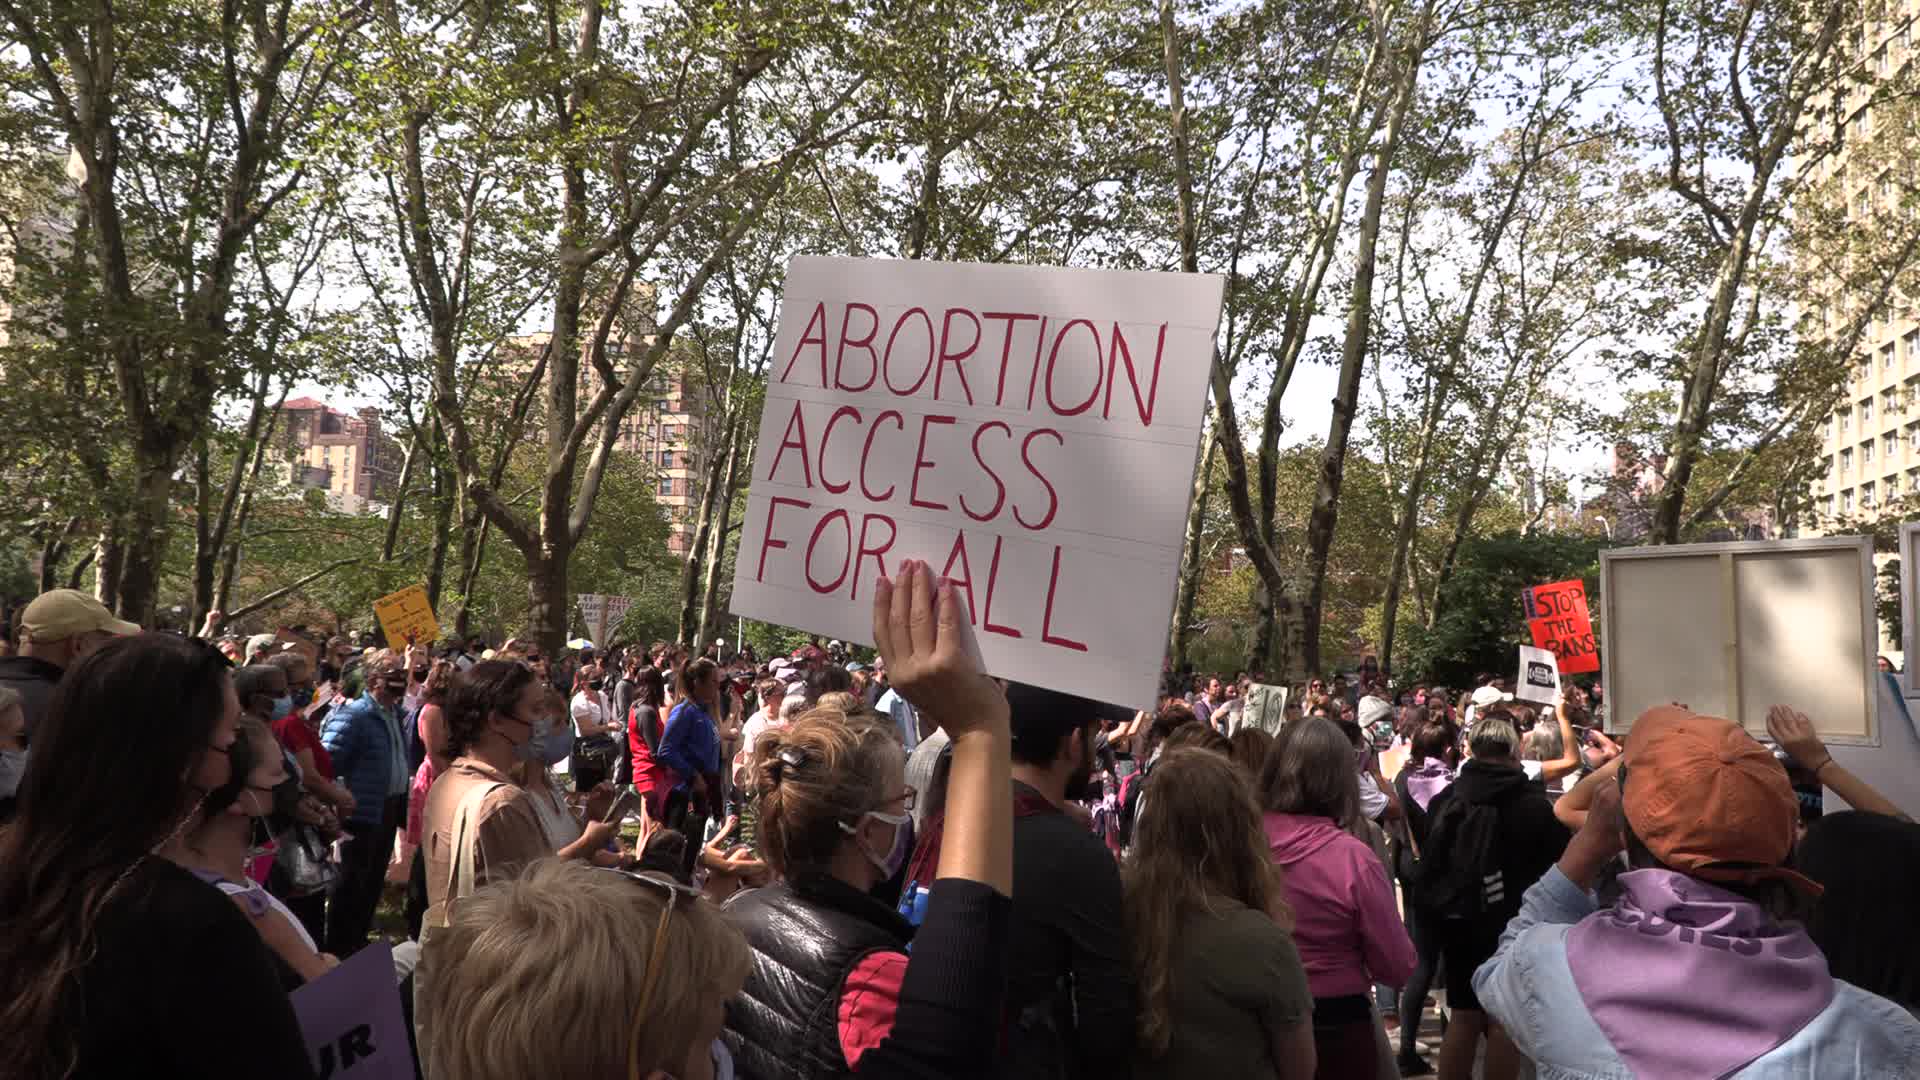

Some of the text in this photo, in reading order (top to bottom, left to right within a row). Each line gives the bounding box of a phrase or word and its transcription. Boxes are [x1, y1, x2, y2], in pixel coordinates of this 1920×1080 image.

[780, 301, 1169, 427] ABORTION
[768, 399, 1064, 531] ACCESS
[757, 496, 1089, 652] FOR ALL
[1535, 588, 1583, 618] STOP
[1543, 617, 1576, 639] THE
[1543, 632, 1597, 661] BANS
